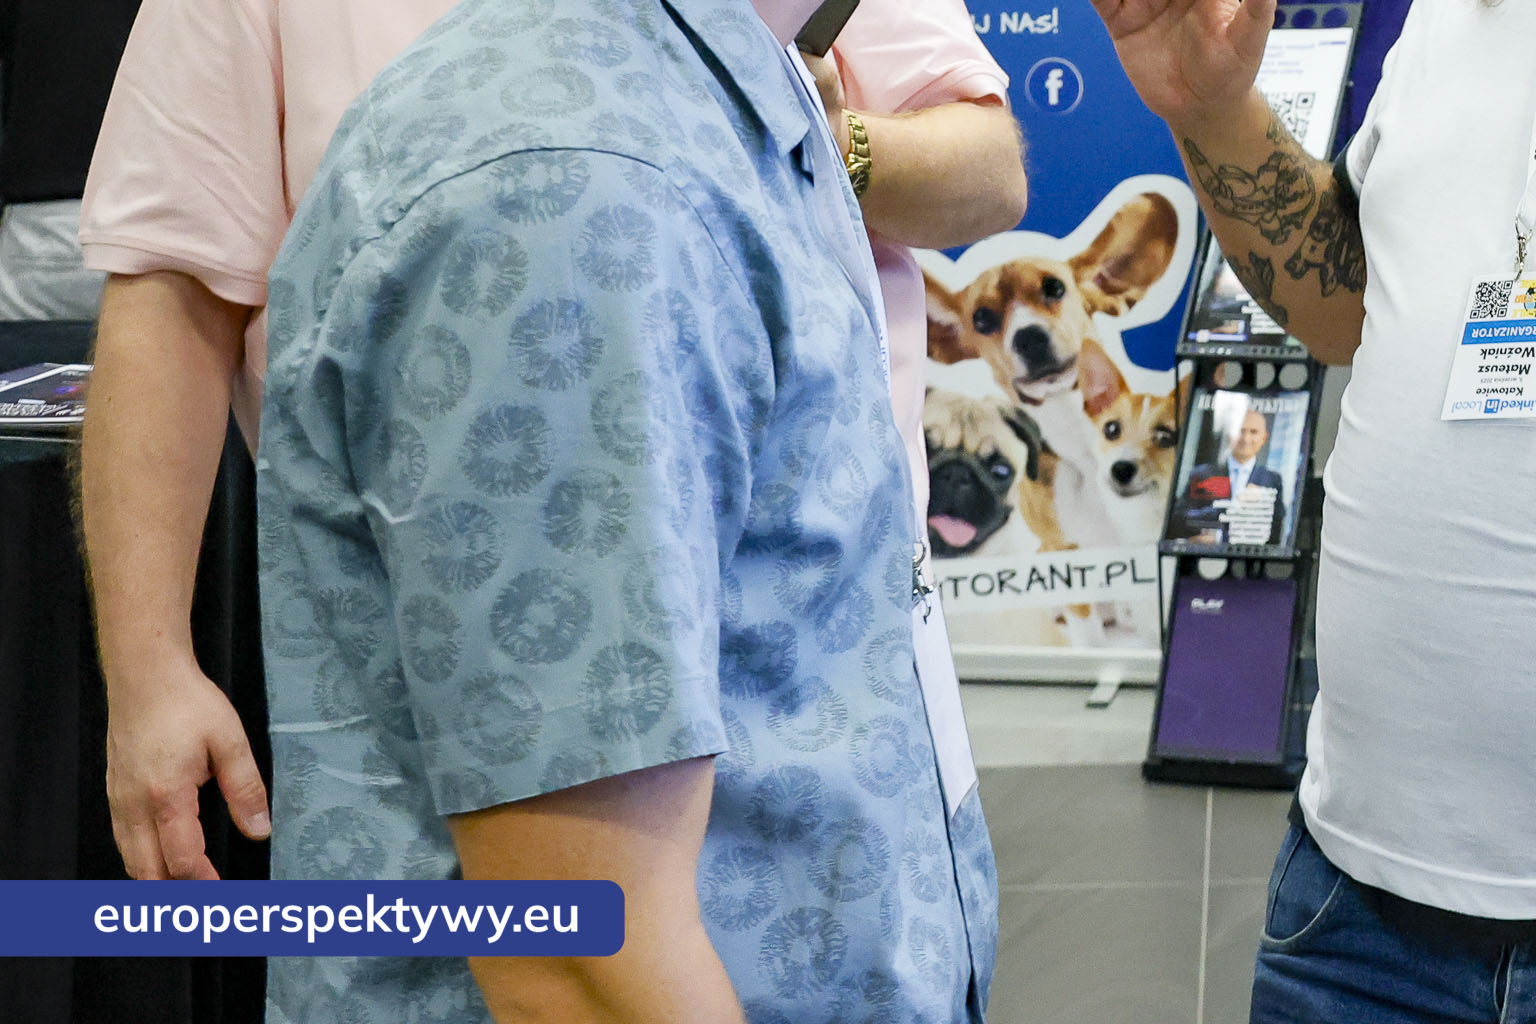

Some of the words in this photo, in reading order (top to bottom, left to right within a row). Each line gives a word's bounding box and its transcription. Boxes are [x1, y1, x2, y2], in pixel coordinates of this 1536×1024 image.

[1000, 8, 1059, 35] NAS!
[1480, 347, 1536, 360] Woźniak
[1478, 364, 1531, 375] Mateusz
[1476, 387, 1523, 397] Katowice
